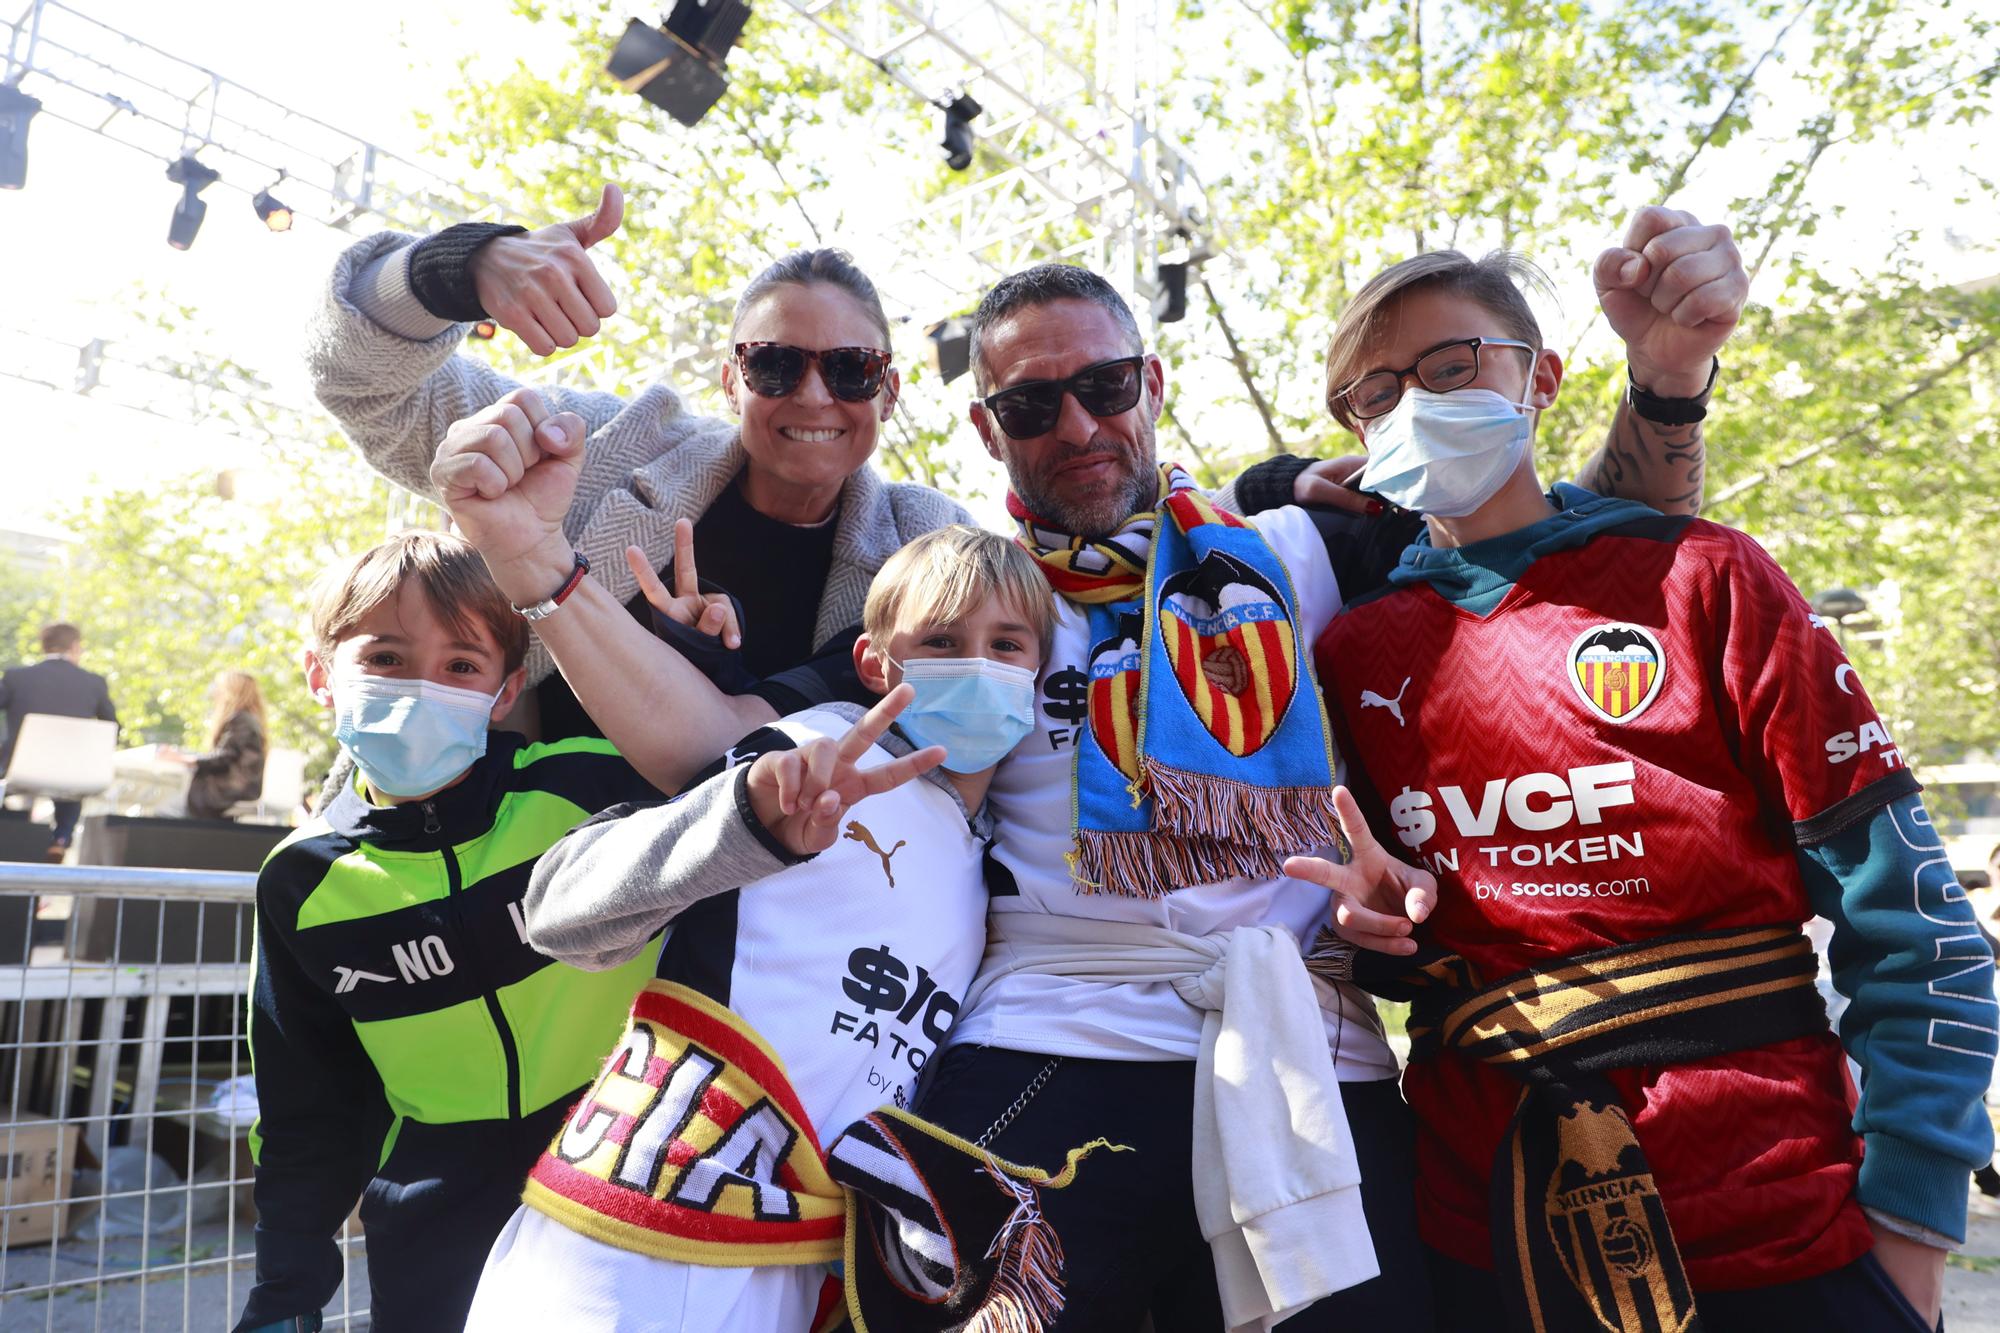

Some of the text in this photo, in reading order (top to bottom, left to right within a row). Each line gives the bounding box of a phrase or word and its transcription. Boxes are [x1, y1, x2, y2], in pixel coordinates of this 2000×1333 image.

[1824, 719, 1895, 764] SA
[1389, 760, 1636, 853] $VCF
[1478, 831, 1646, 868] TOKEN
[1475, 881, 1504, 900] by
[866, 1065, 893, 1094] by
